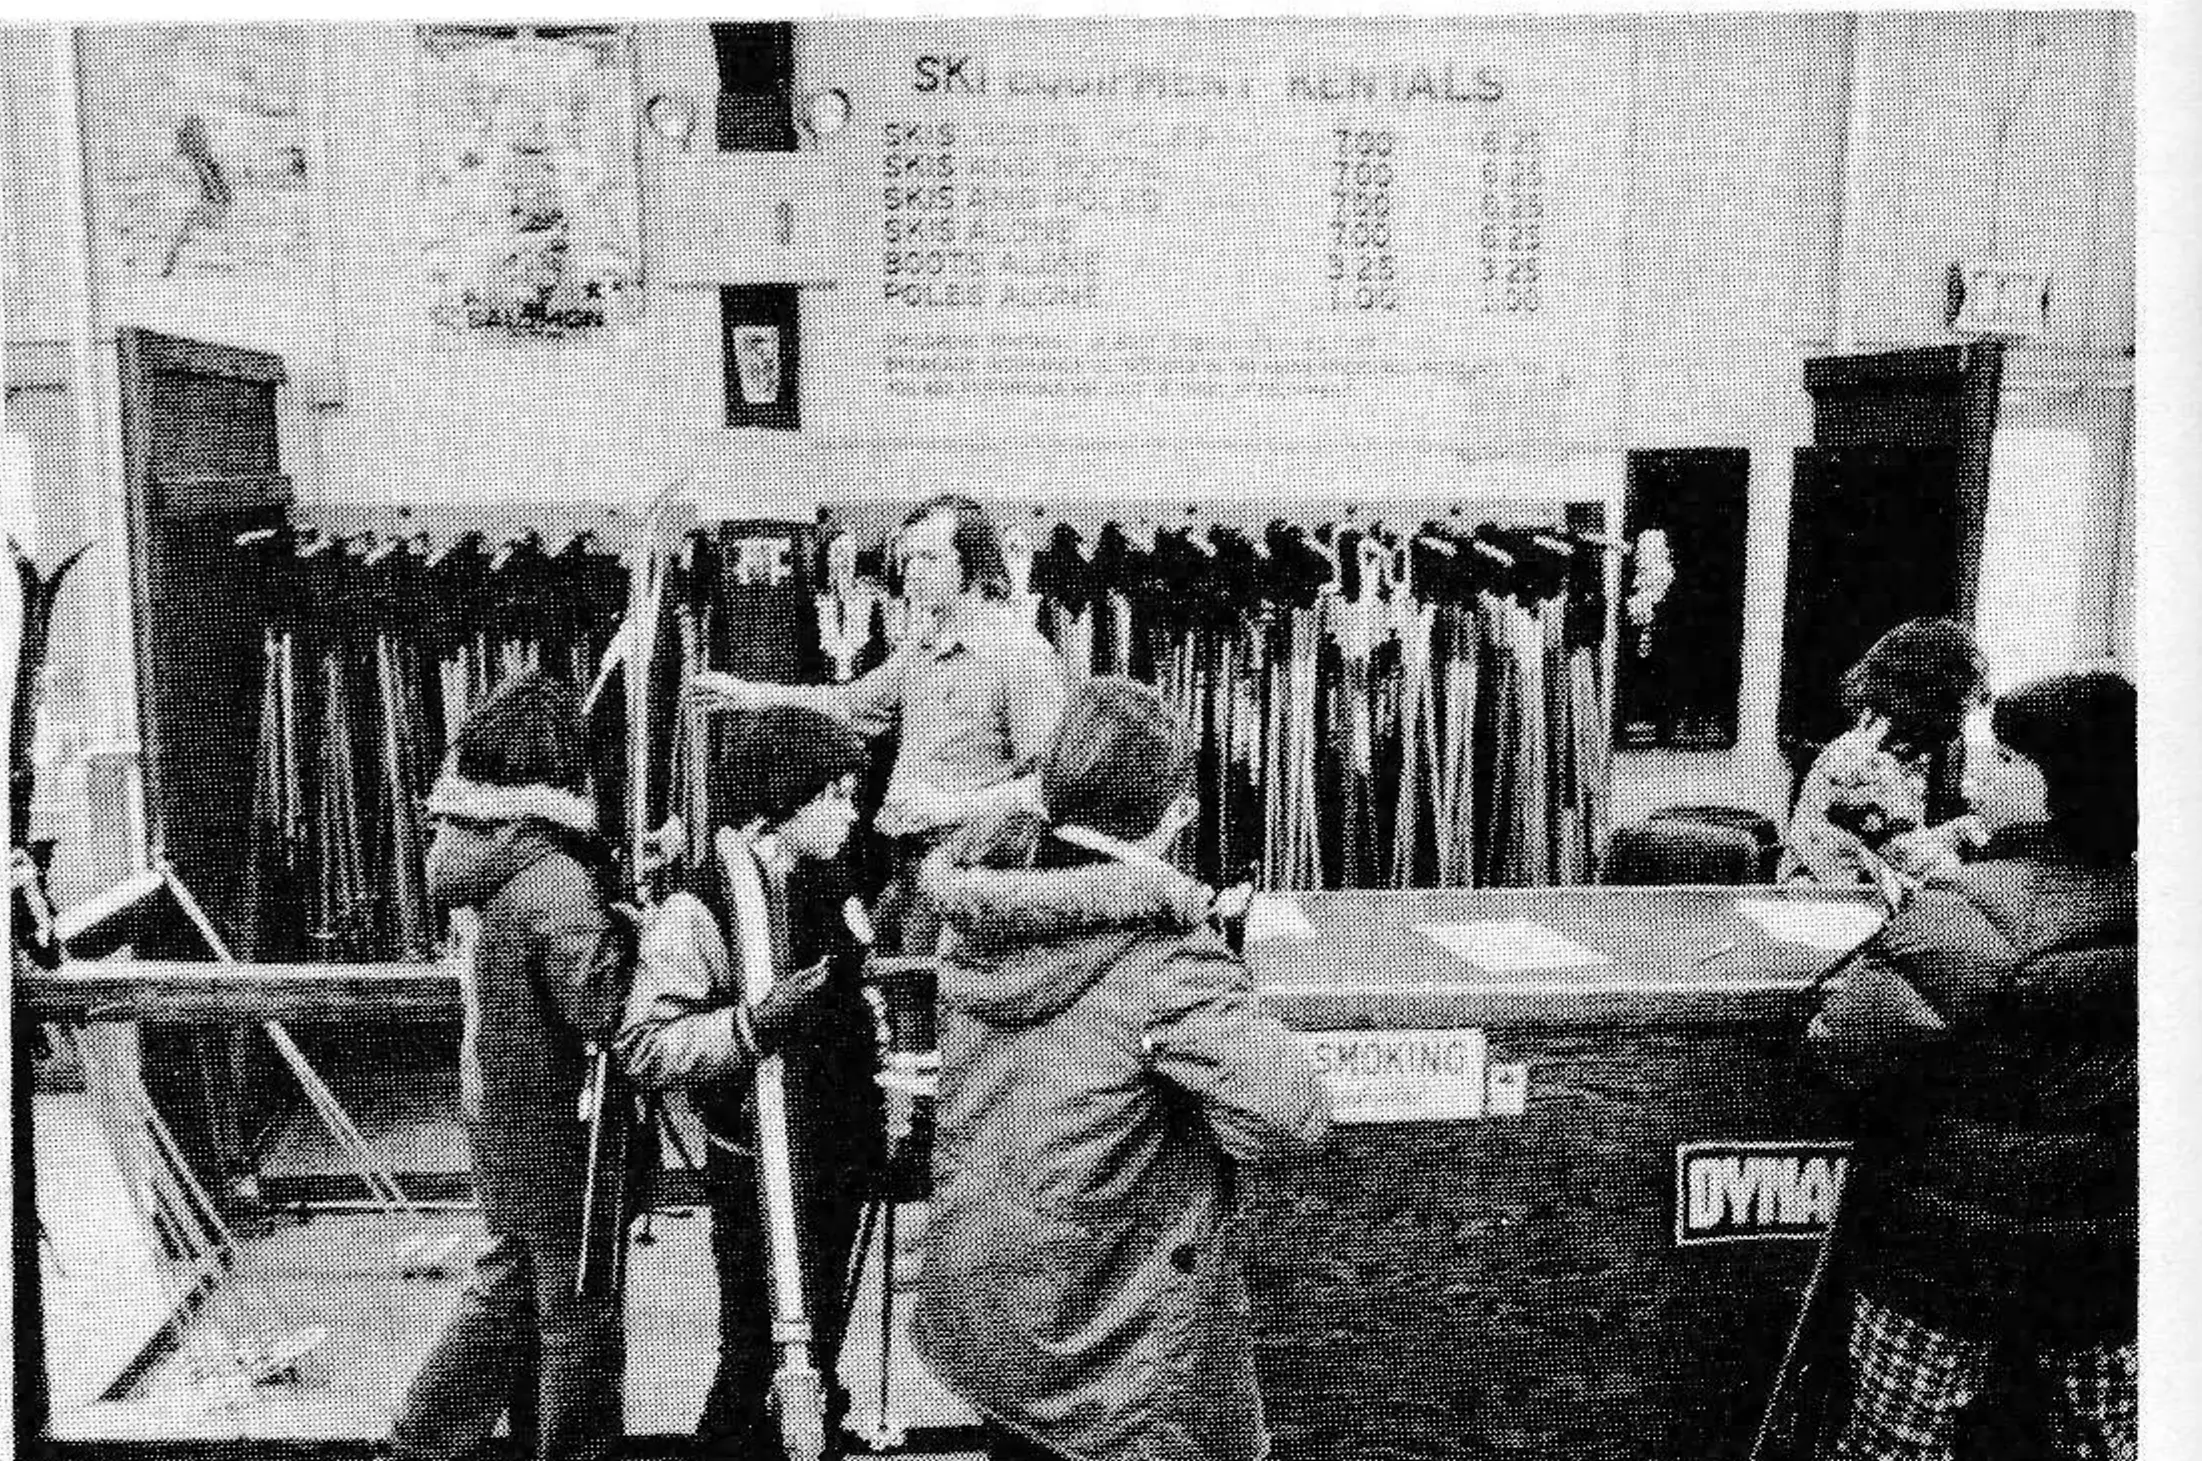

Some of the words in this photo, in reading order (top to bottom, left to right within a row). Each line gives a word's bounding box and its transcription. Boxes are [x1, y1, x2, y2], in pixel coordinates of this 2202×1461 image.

[912, 54, 988, 96] SKI
[1286, 62, 1505, 102] RENTALS
[884, 153, 956, 179] SKIS
[884, 186, 956, 211] SKIS
[884, 218, 956, 244] SKIS
[968, 218, 1073, 244] ALONE
[884, 250, 985, 276] BOOTS
[999, 251, 1101, 277] ALONE
[884, 282, 983, 307] POLES
[998, 283, 1100, 308] ALONE
[1314, 1040, 1466, 1077] SMOKING
